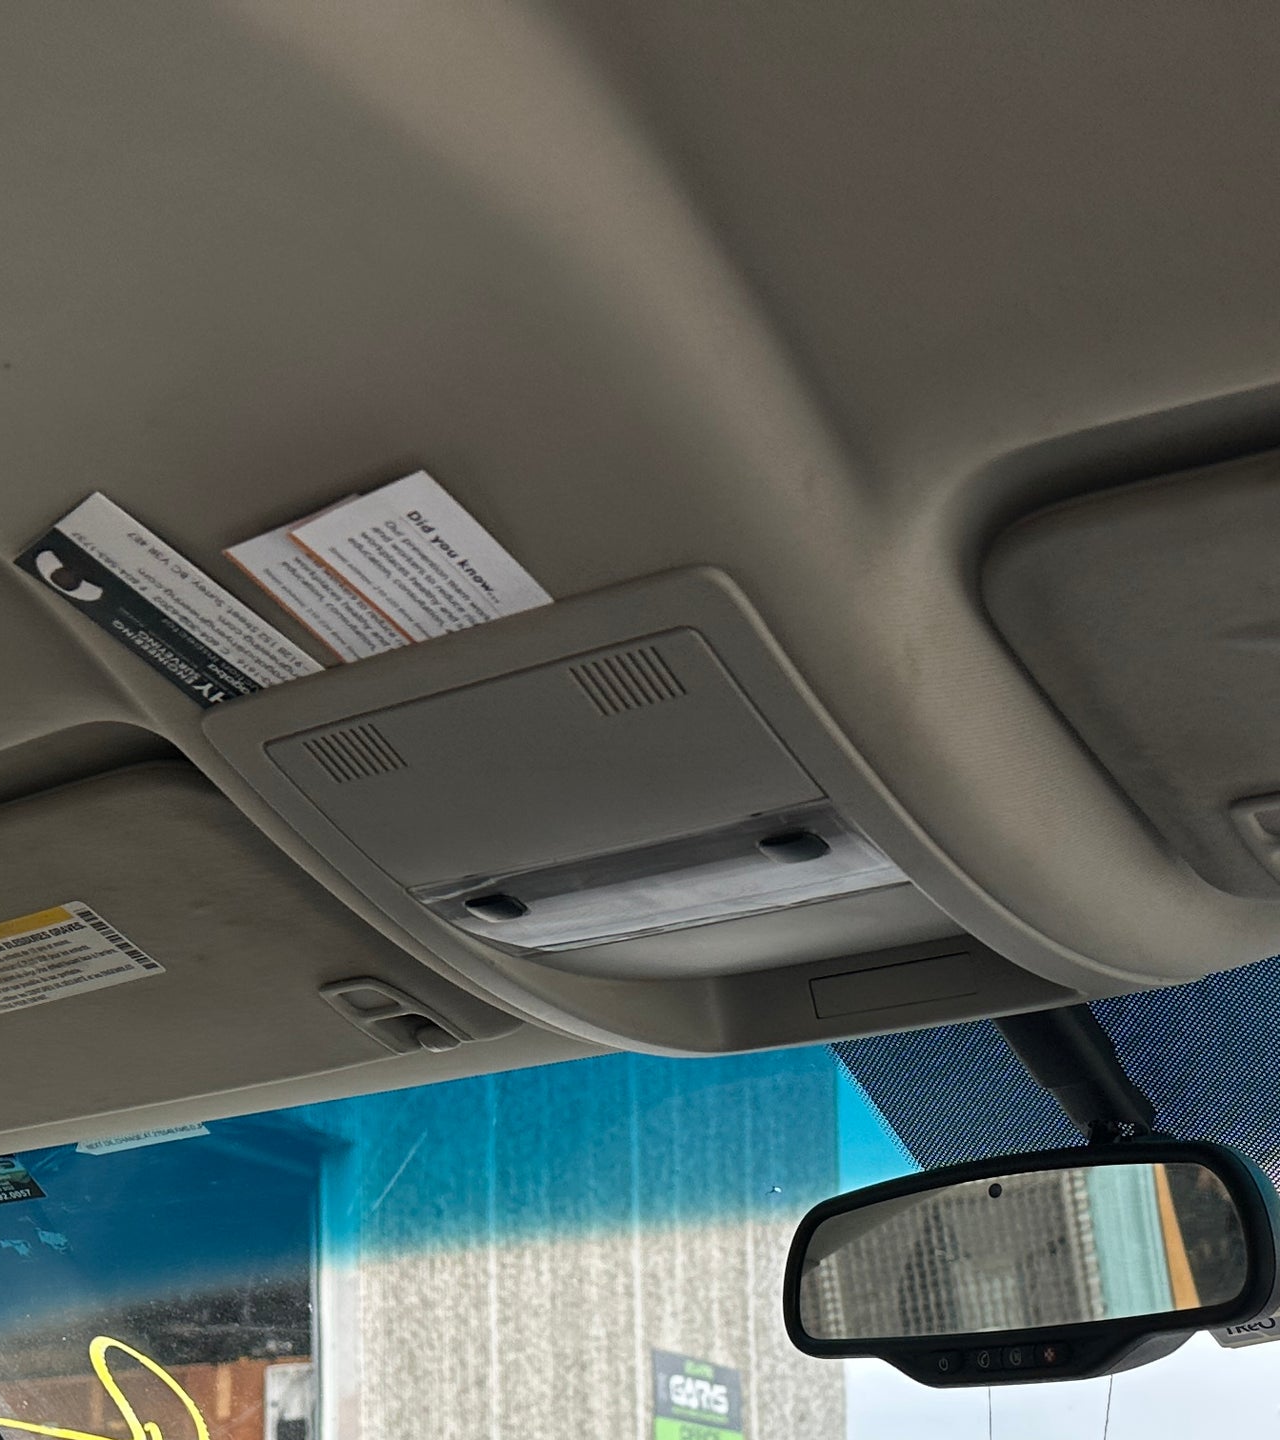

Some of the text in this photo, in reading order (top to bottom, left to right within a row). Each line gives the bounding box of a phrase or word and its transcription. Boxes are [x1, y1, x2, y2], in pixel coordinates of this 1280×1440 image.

[407, 510, 435, 534] Did
[430, 535, 459, 559] you
[109, 618, 197, 684] ENGINEERING
[134, 628, 203, 680] SURVEYING
